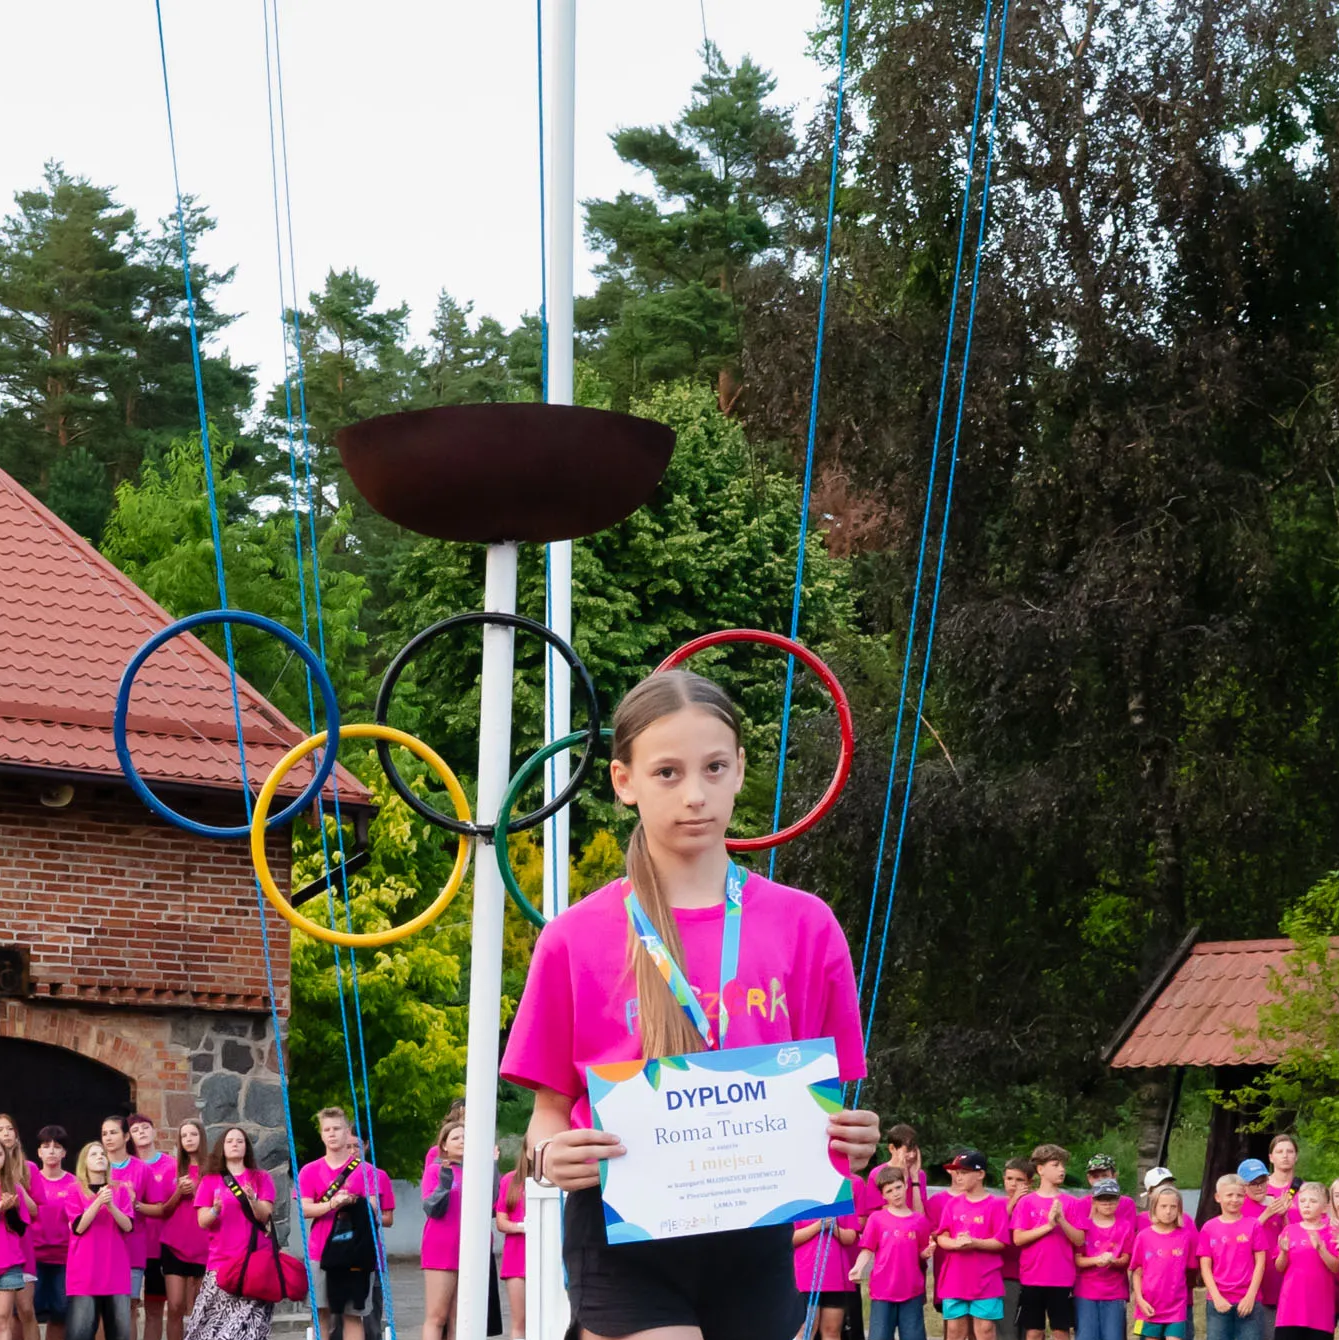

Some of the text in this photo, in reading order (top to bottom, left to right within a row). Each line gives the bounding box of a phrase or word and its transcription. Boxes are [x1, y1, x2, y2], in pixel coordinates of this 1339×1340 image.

[666, 1080, 767, 1111] DYPLOM
[655, 1114, 788, 1145] Roma Turska
[702, 1153, 765, 1172] miejsca
